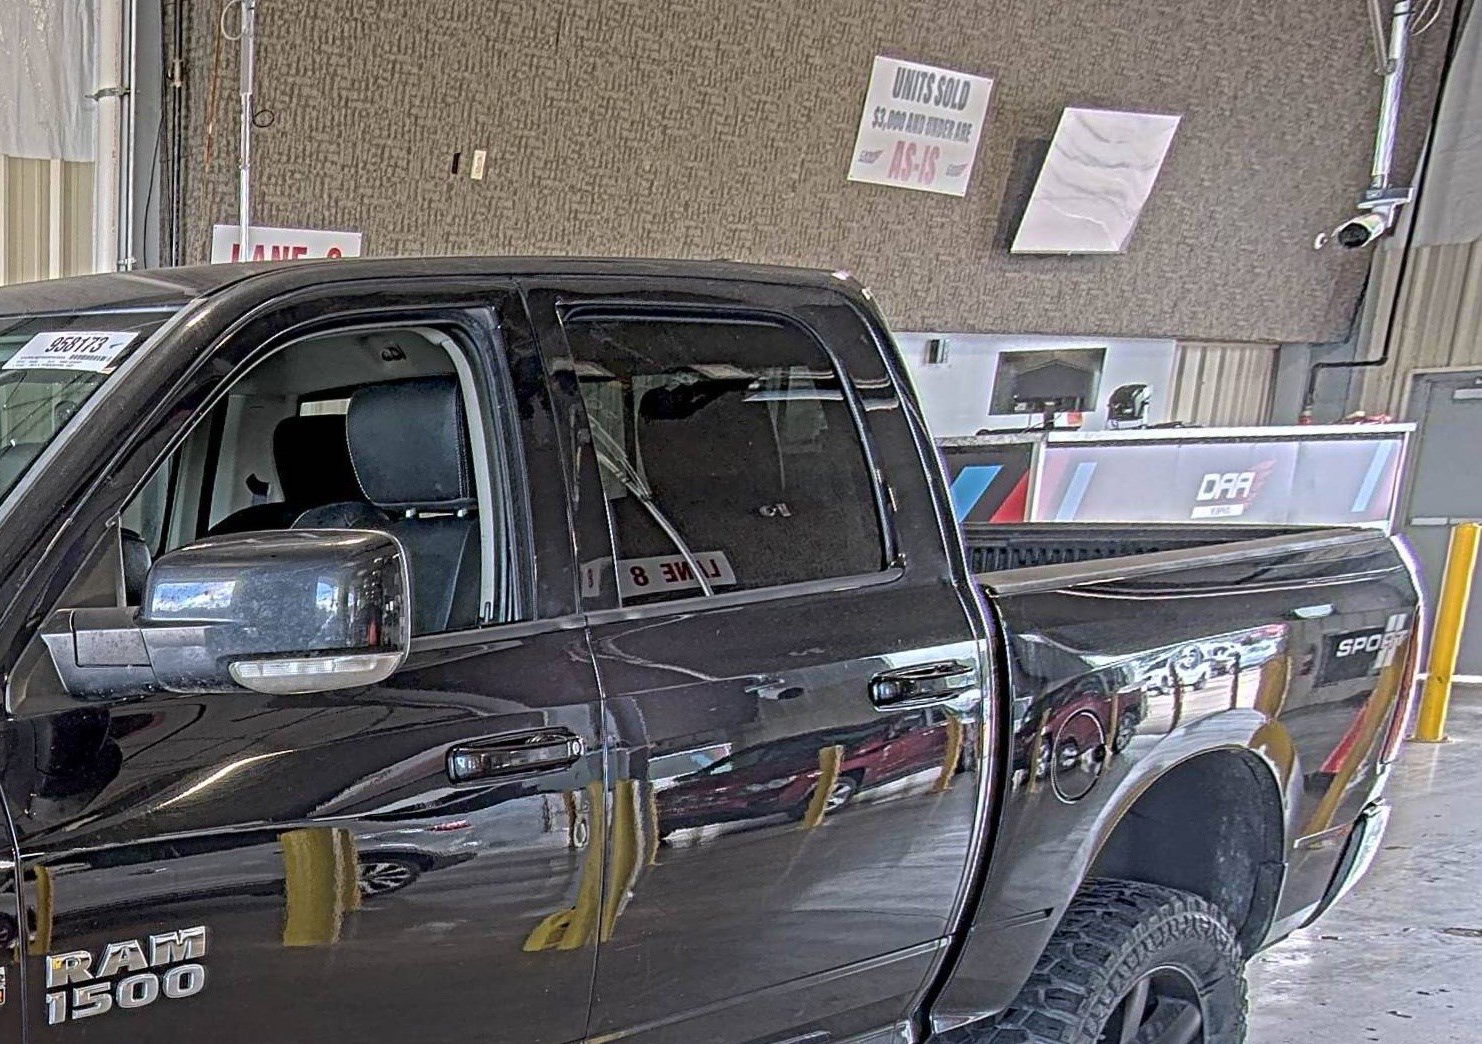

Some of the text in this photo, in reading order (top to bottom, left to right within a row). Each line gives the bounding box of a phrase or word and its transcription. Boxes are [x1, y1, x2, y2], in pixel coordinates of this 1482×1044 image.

[892, 66, 971, 111] UNITS SOLD
[888, 140, 941, 185] AS-IS
[45, 336, 109, 353] 958173
[1196, 471, 1256, 501] DAA
[1336, 630, 1409, 657] SPORT
[46, 925, 206, 988] RAM
[46, 963, 205, 1025] 1500
